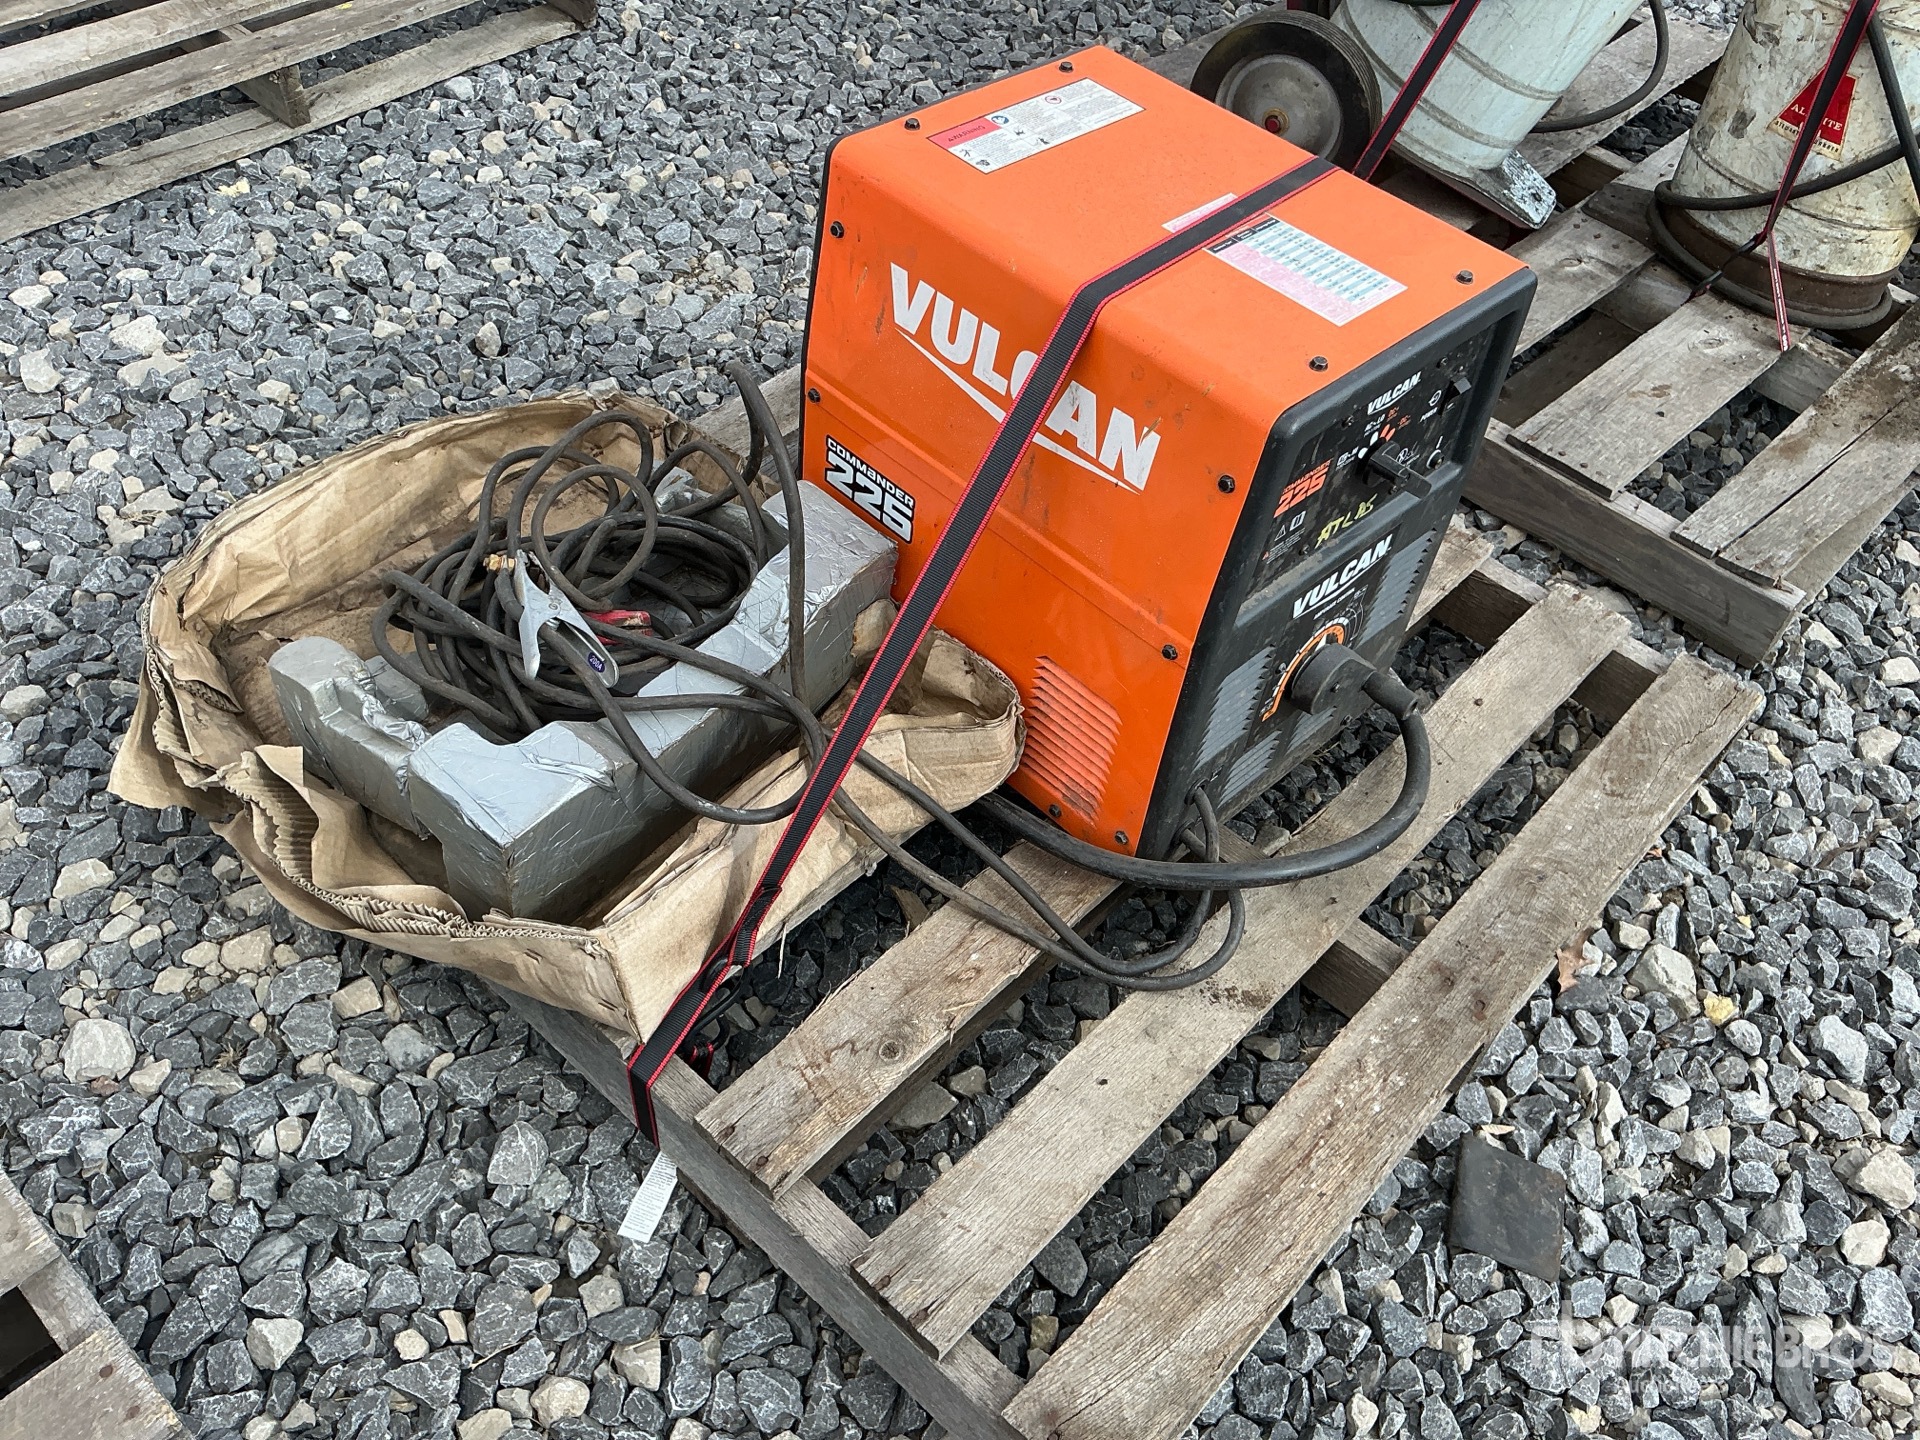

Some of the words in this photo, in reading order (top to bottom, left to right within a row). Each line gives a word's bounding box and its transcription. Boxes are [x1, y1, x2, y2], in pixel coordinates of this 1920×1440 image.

[1791, 104, 1843, 130] ALITE
[1368, 371, 1421, 415] VULCAN
[826, 450, 913, 542] 225
[1274, 465, 1330, 518] 225
[1293, 534, 1392, 618] VULCAN
